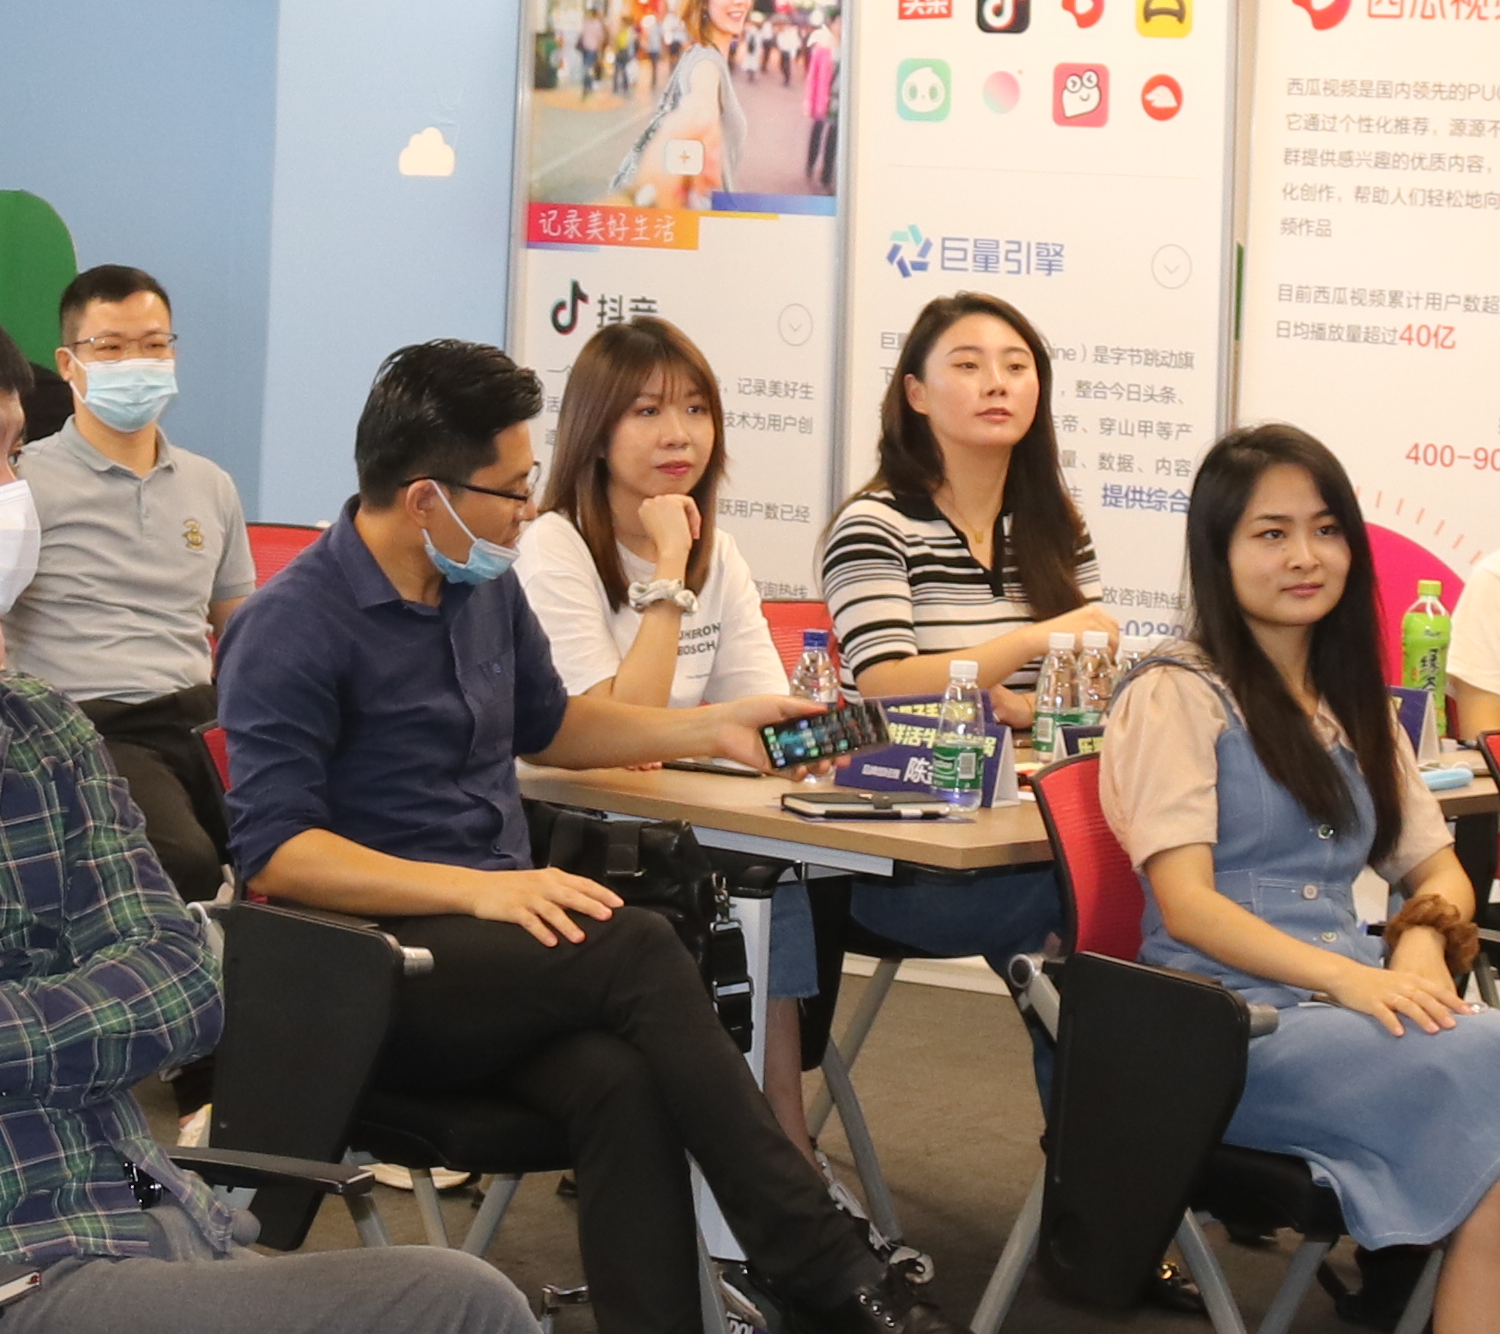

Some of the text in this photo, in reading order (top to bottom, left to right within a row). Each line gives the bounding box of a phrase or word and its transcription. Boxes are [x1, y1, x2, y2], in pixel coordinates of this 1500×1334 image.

[538, 209, 676, 244] 记录美好生活
[1279, 217, 1333, 238] 频作品
[940, 236, 1066, 277] 巨量引擎
[1275, 320, 1457, 350] 日均播放量超过40亿
[903, 756, 934, 785] 陈
